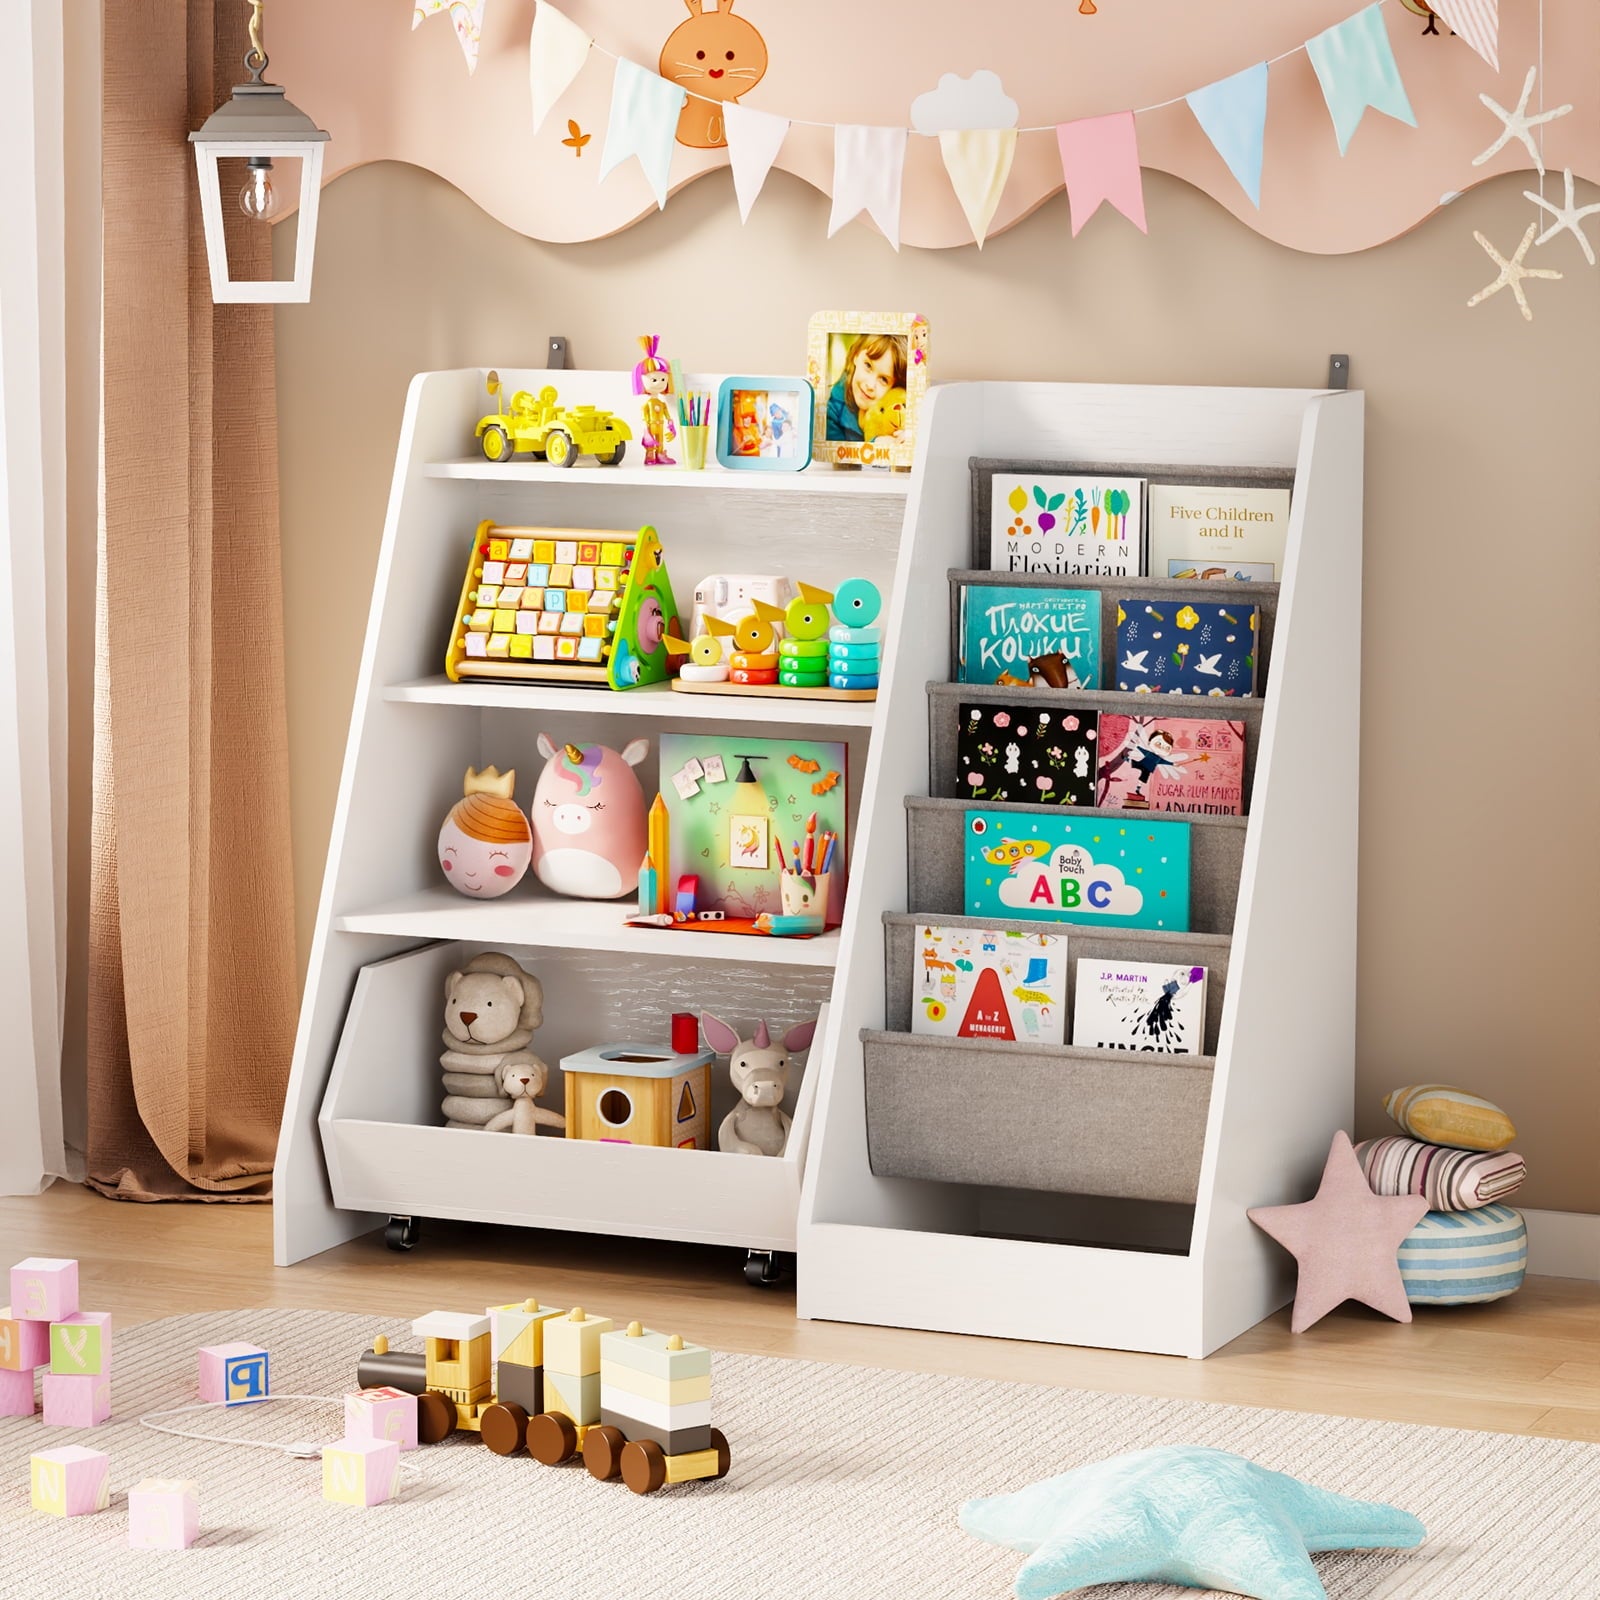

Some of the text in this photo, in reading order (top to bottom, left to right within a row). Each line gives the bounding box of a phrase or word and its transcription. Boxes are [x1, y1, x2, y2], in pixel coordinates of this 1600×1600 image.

[1169, 505, 1274, 523] Five Children
[1199, 524, 1245, 539] and It
[1007, 541, 1128, 557] MODERN
[740, 672, 748, 682] 2
[790, 674, 797, 685] 4
[1157, 783, 1185, 798] SUGAR
[1187, 784, 1209, 799] PLUM
[1059, 855, 1082, 871] Baby
[1059, 864, 1085, 875] Touch
[1029, 874, 1113, 909] ABC
[1116, 974, 1148, 983] MARTIN
[976, 1009, 984, 1021] A
[993, 1011, 1000, 1022] Z
[969, 1023, 1006, 1034] MENAGERIE
[39, 1465, 59, 1502] N
